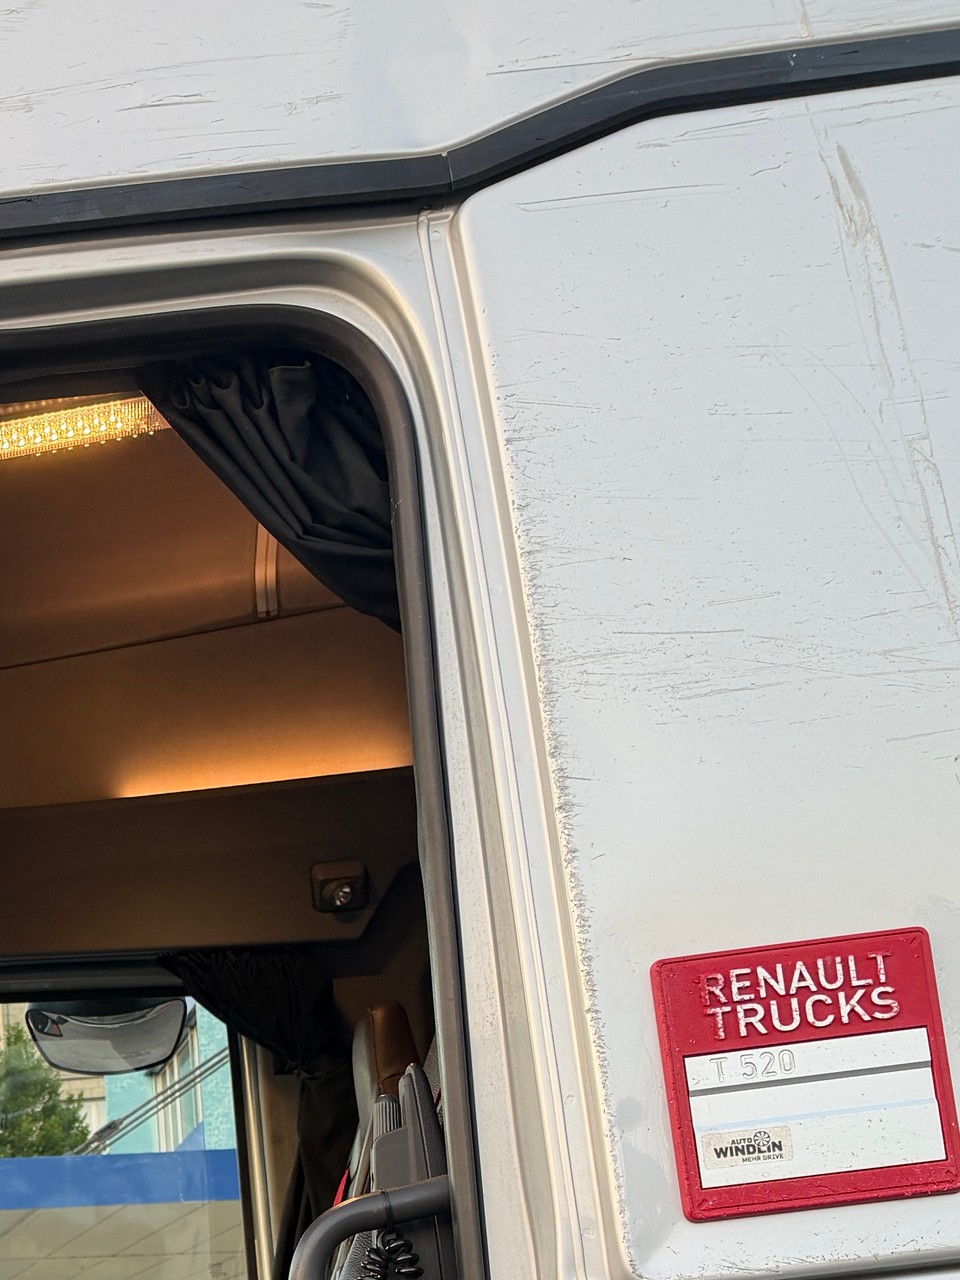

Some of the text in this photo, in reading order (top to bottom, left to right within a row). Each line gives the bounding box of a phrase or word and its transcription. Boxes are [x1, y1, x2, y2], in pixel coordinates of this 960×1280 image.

[699, 952, 892, 1006] RENAULT
[706, 986, 901, 1040] TRUCKS
[709, 1048, 797, 1083] T 520
[713, 1140, 783, 1159] WINDLIN
[730, 1137, 752, 1145] AUTO
[742, 1153, 784, 1163] MEHR DRIVE
